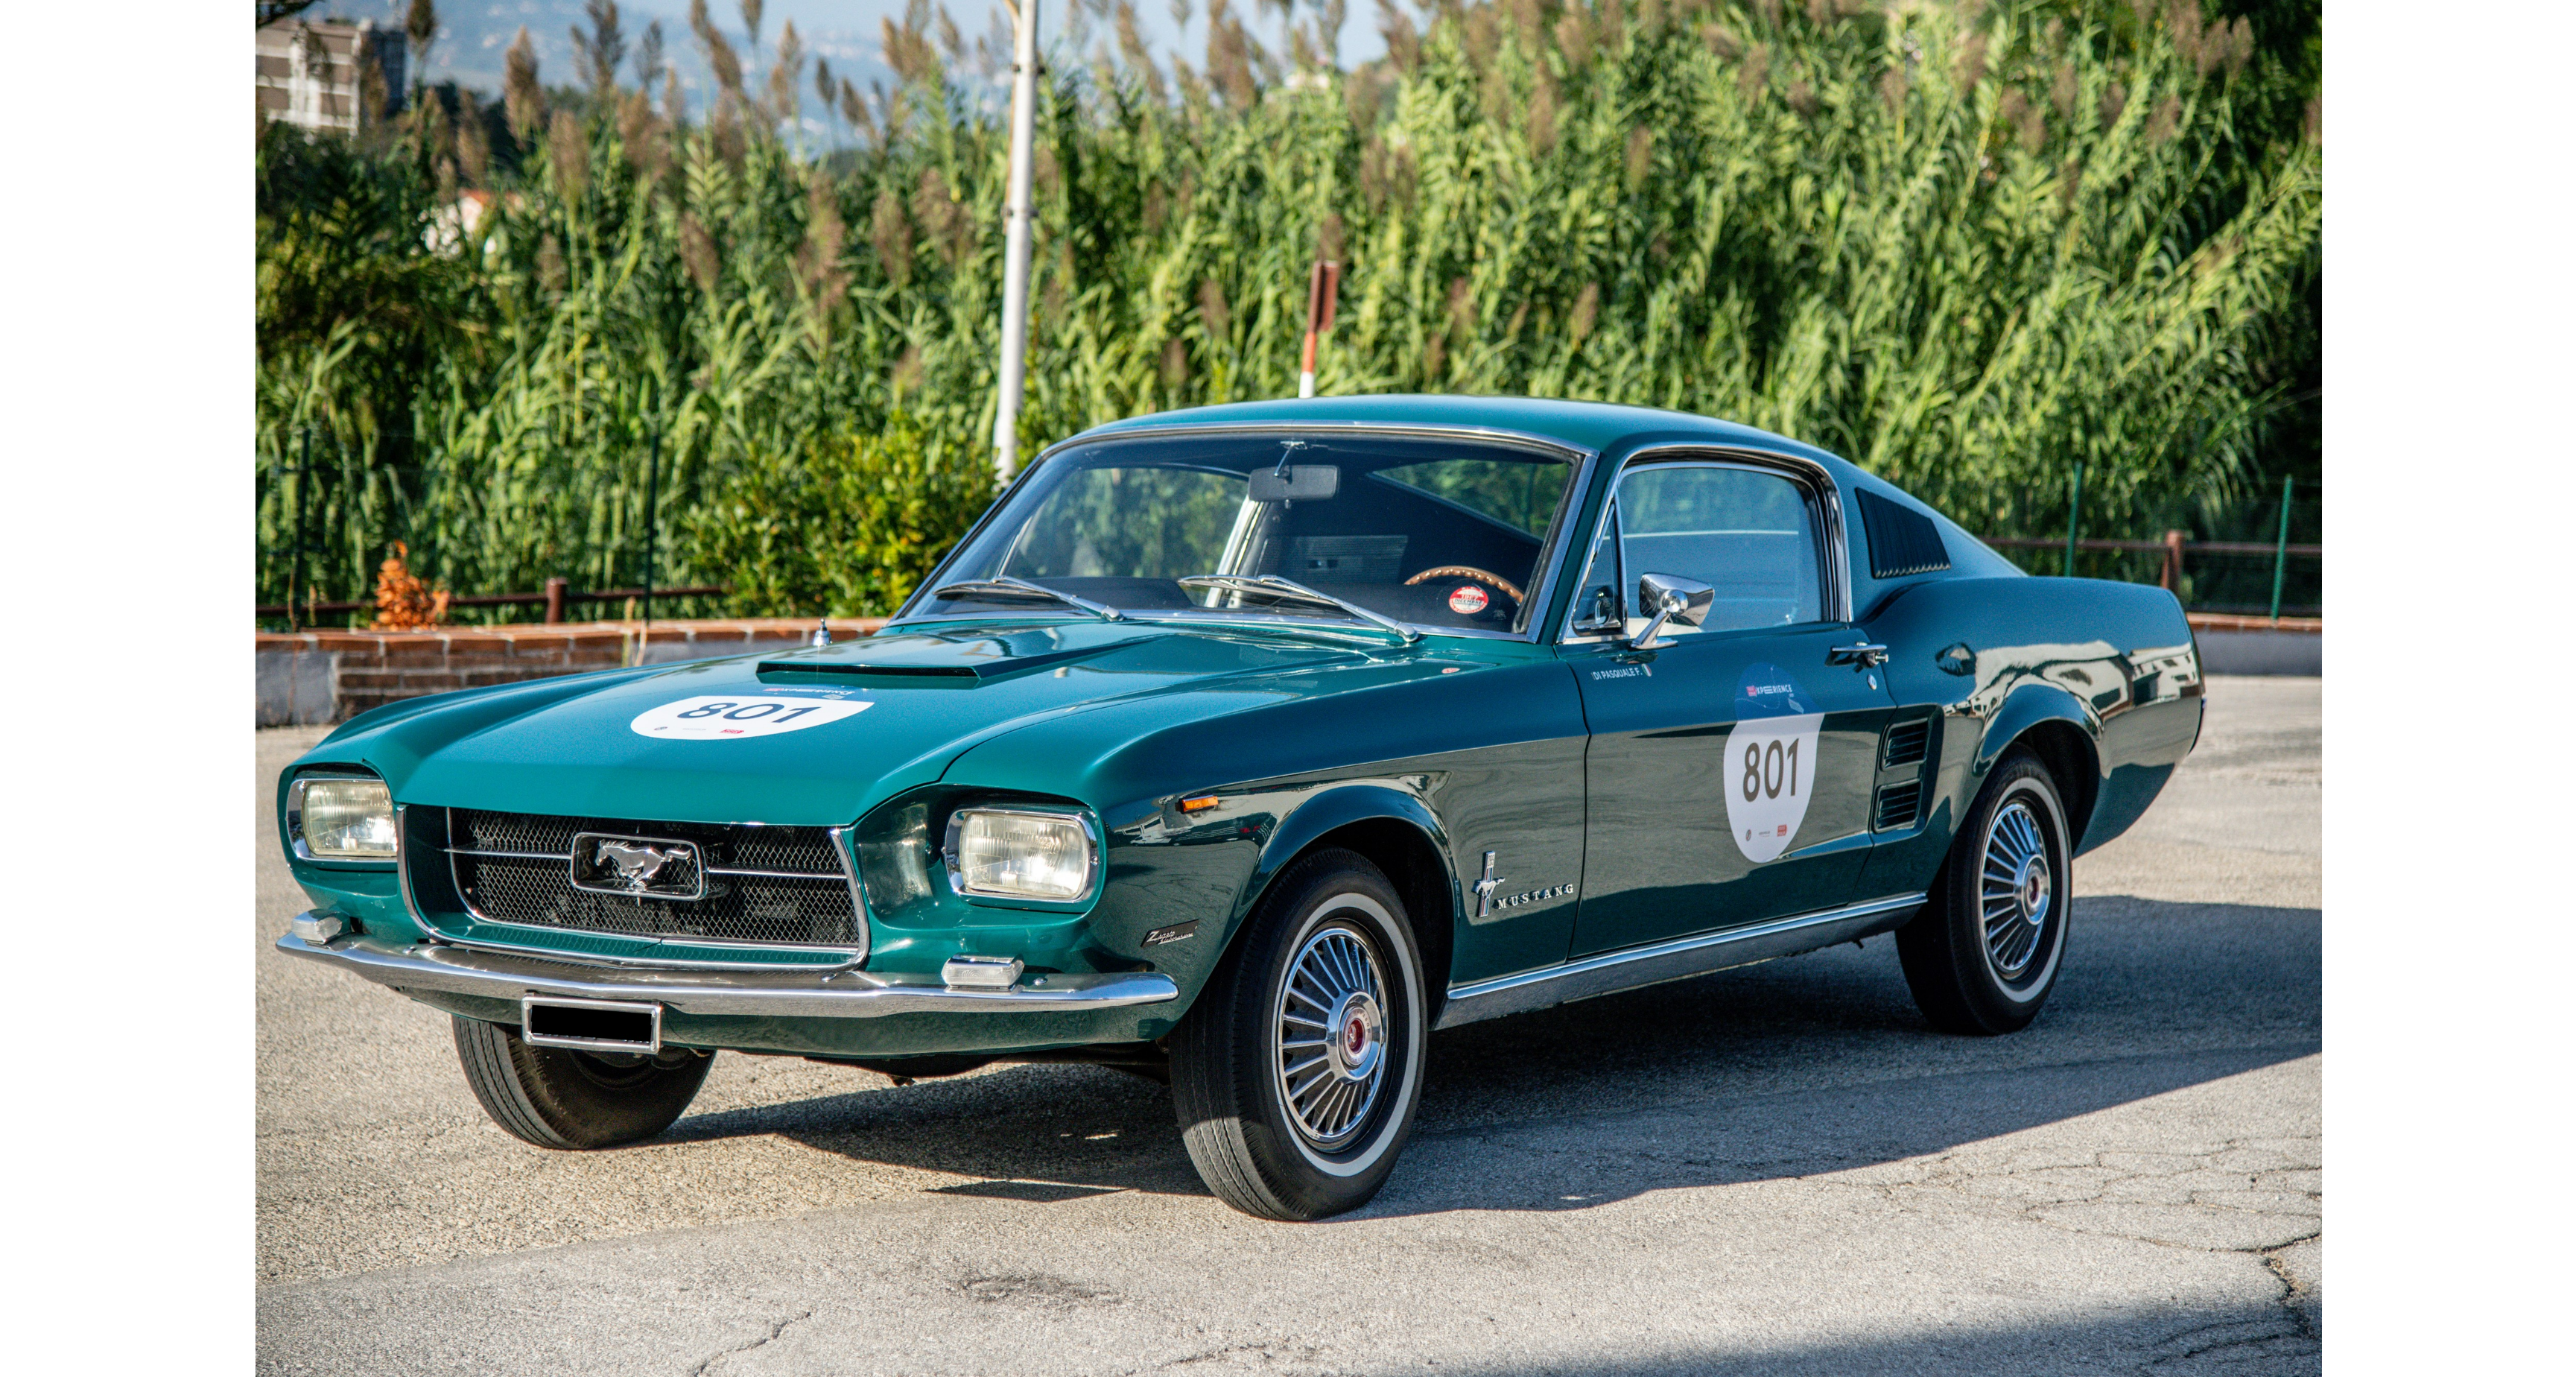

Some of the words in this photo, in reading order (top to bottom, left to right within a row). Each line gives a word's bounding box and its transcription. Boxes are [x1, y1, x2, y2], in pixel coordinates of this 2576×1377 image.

[1593, 671, 1602, 680] DI
[1601, 668, 1636, 680] PASQUALE
[1634, 667, 1643, 676] F.
[677, 703, 822, 724] 801
[1742, 738, 1799, 803] 801
[1498, 884, 1573, 909] MUSTANG
